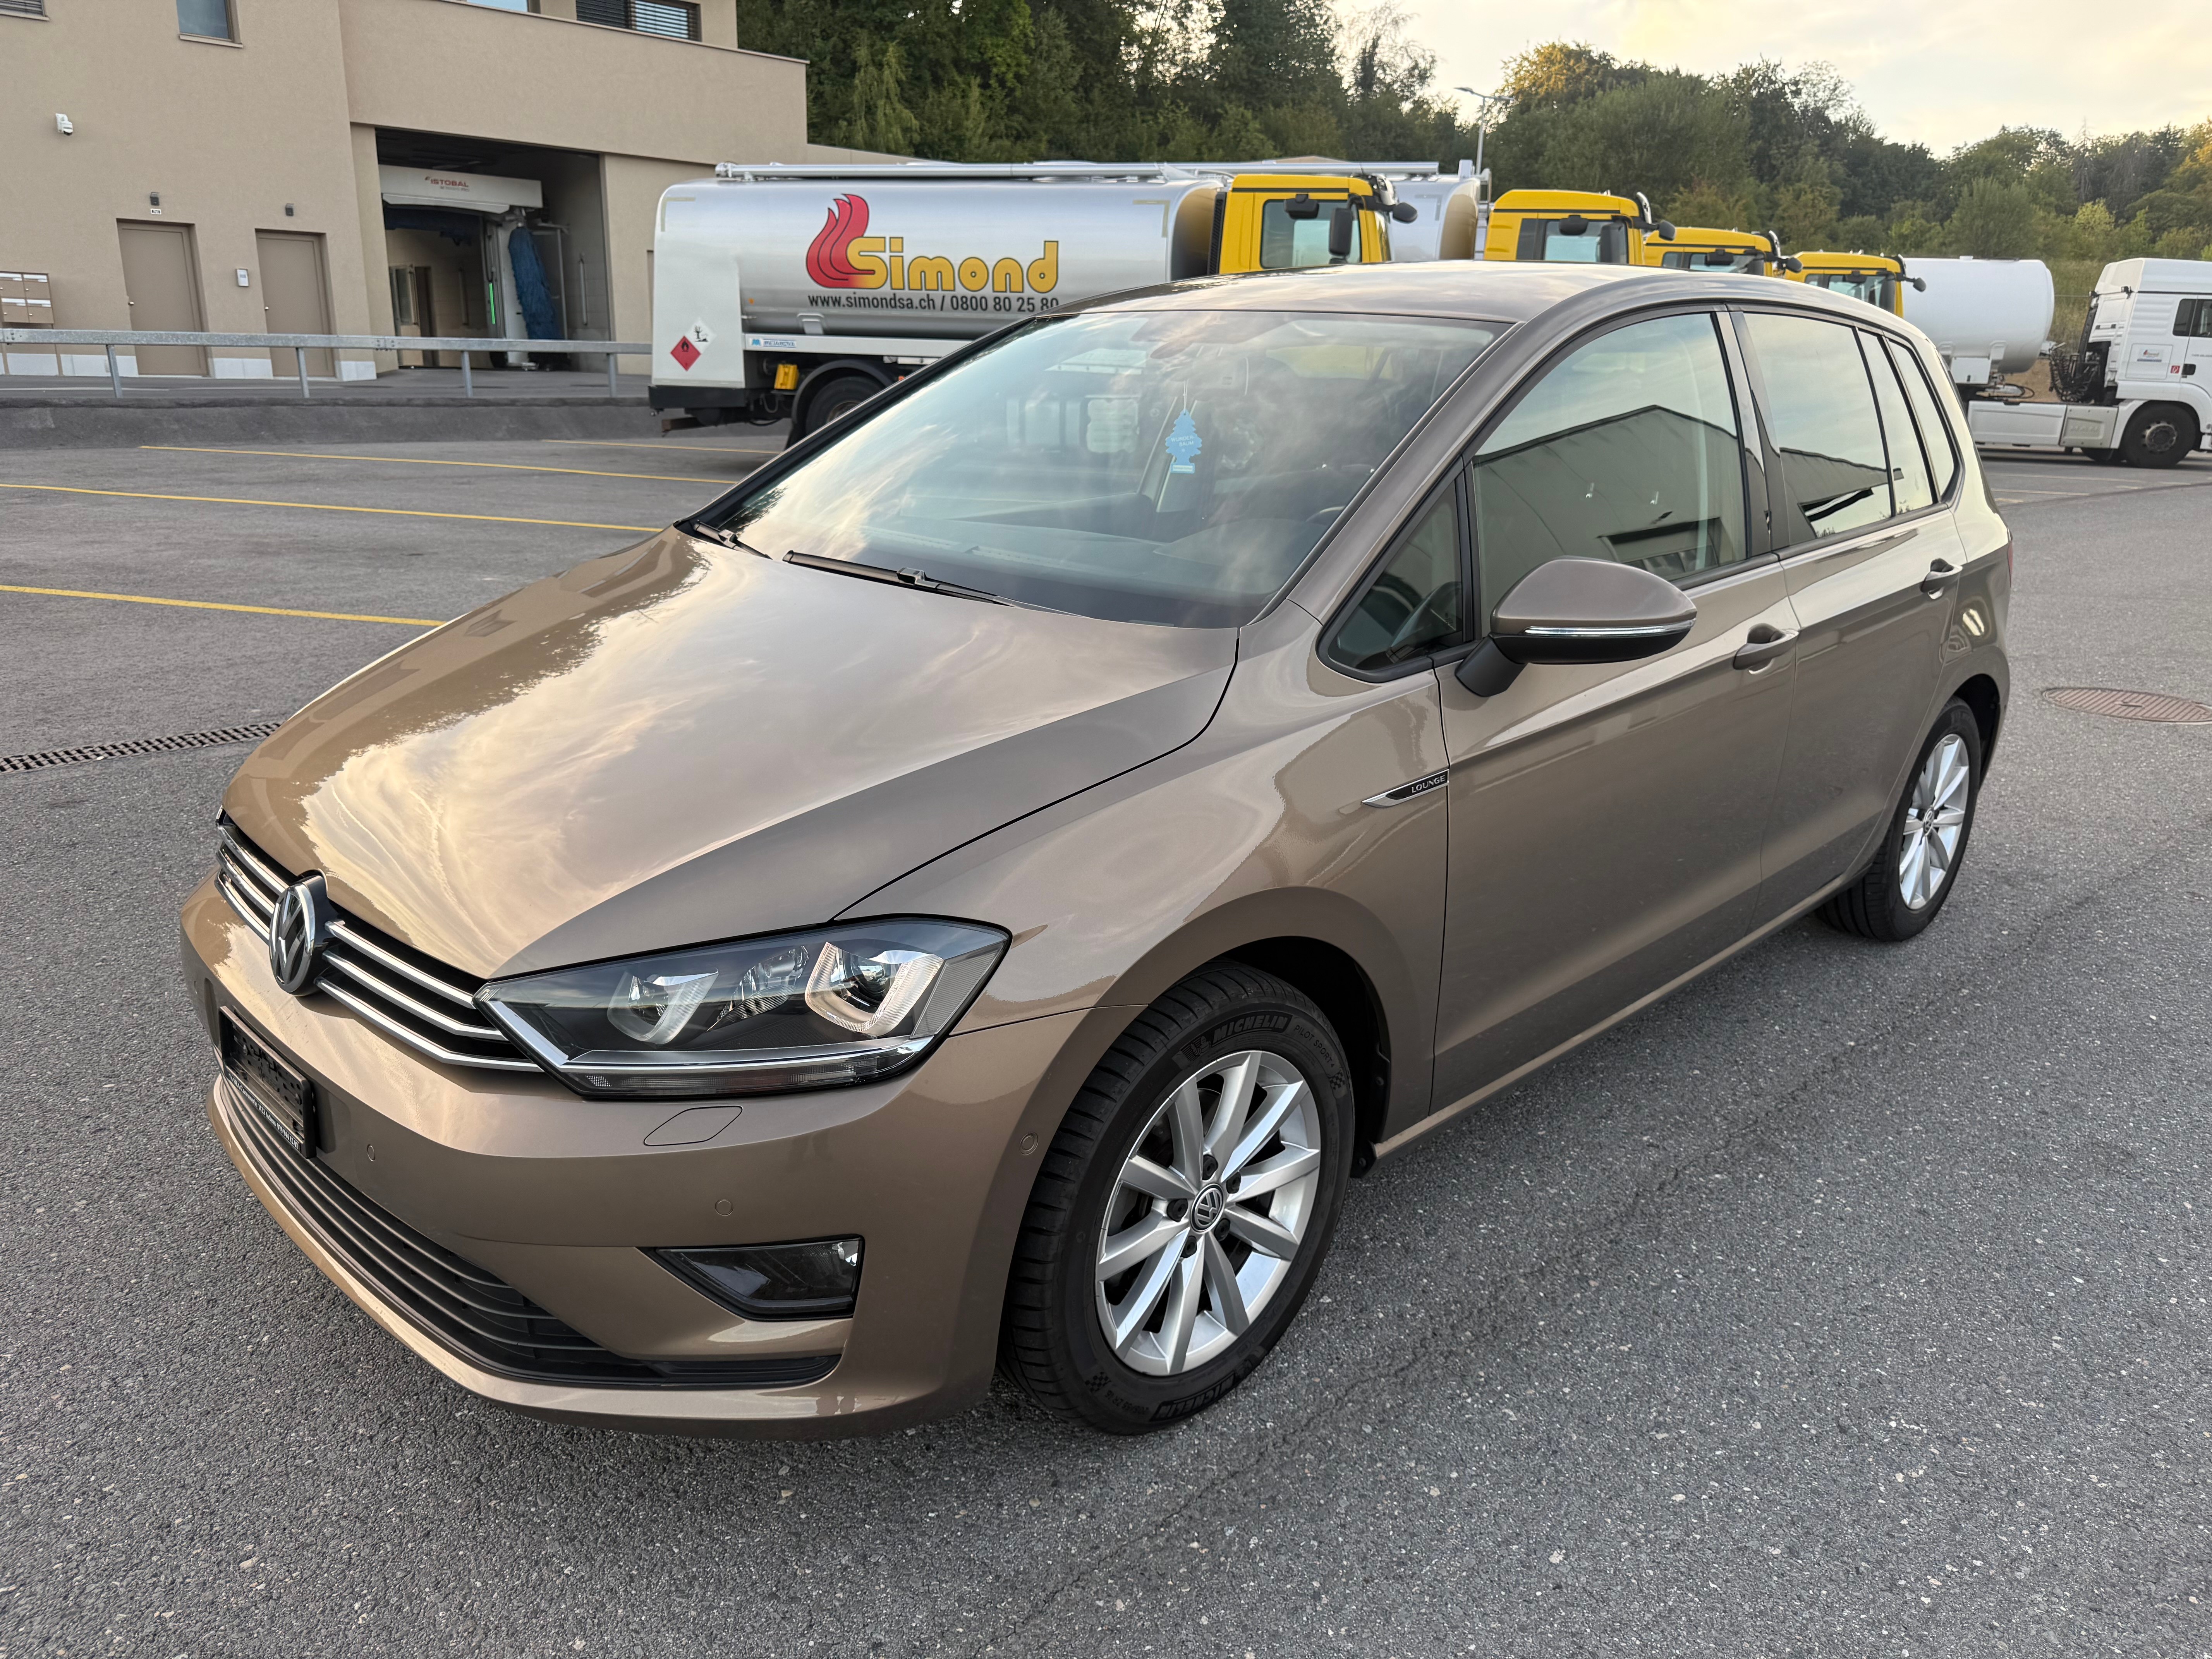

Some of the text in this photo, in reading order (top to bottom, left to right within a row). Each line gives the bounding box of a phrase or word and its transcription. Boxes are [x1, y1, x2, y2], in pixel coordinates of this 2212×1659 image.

[845, 237, 1059, 294] Simond
[808, 292, 935, 310] www.simondsa.ch
[940, 295, 945, 311] /
[951, 295, 988, 311] 0800
[993, 297, 1012, 312] 80
[1017, 297, 1035, 312] 25
[1412, 775, 1446, 793] LOUNGE
[1213, 1015, 1288, 1044] MICHELIN
[1295, 1024, 1315, 1041] PILOT
[1313, 1039, 1333, 1063] SPORT
